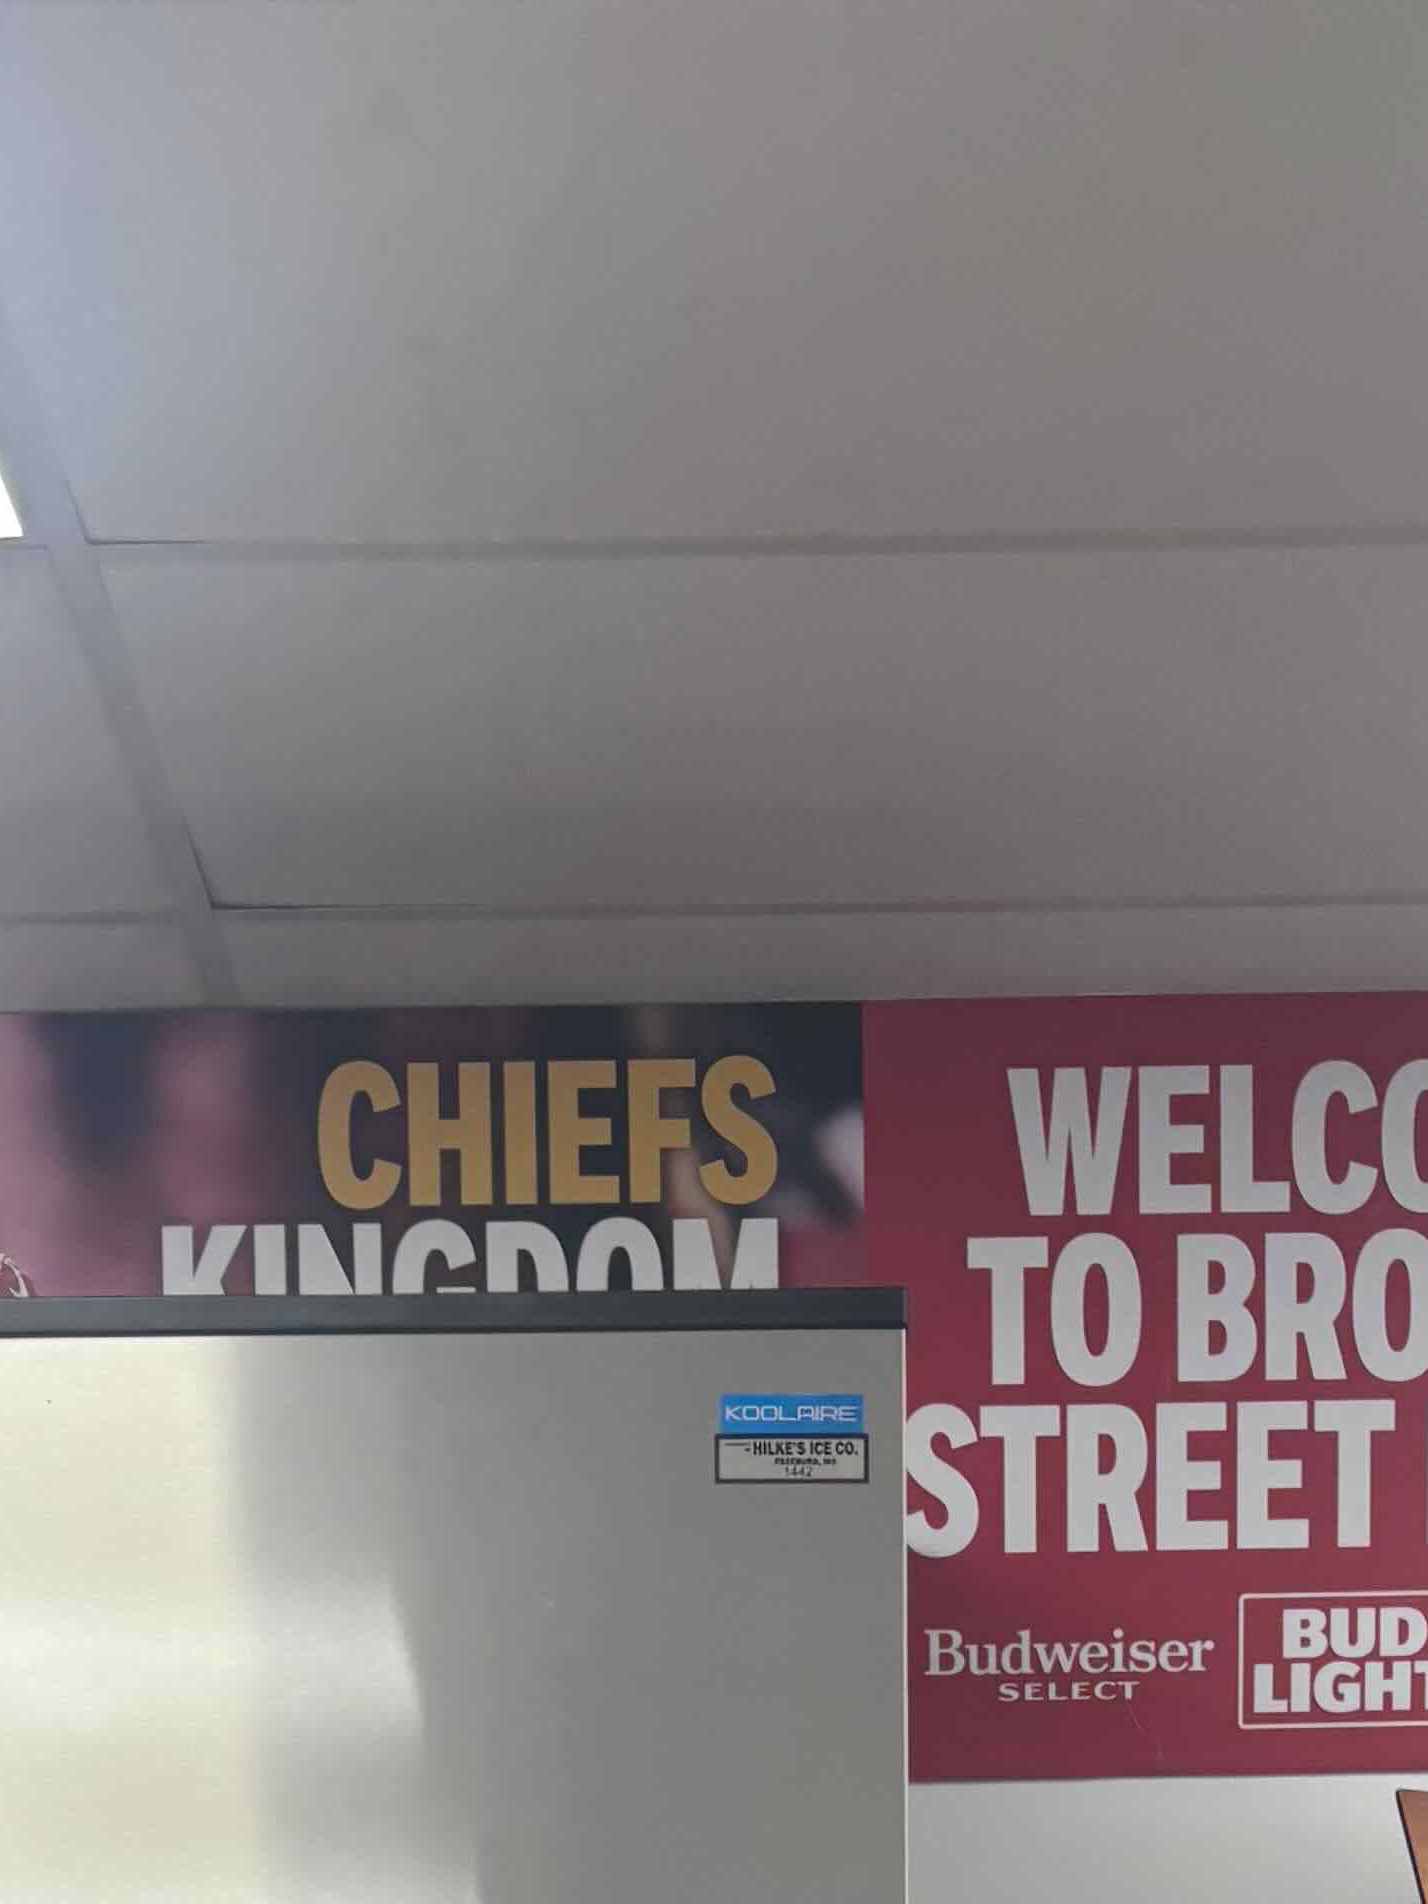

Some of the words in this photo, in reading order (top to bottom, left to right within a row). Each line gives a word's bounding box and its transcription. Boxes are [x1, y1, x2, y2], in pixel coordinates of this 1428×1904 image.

[318, 1055, 777, 1210] CHIEFS
[967, 1232, 1142, 1386] TO
[725, 1405, 859, 1422] KOOLAIRE
[753, 1441, 806, 1456] HILKE'S
[810, 1441, 832, 1455] ICE
[836, 1441, 859, 1455] CO.
[906, 1399, 1395, 1558] STREET
[924, 1628, 1215, 1677] Budweiser
[1282, 1607, 1428, 1658] BUD
[998, 1681, 1140, 1702] SELECT
